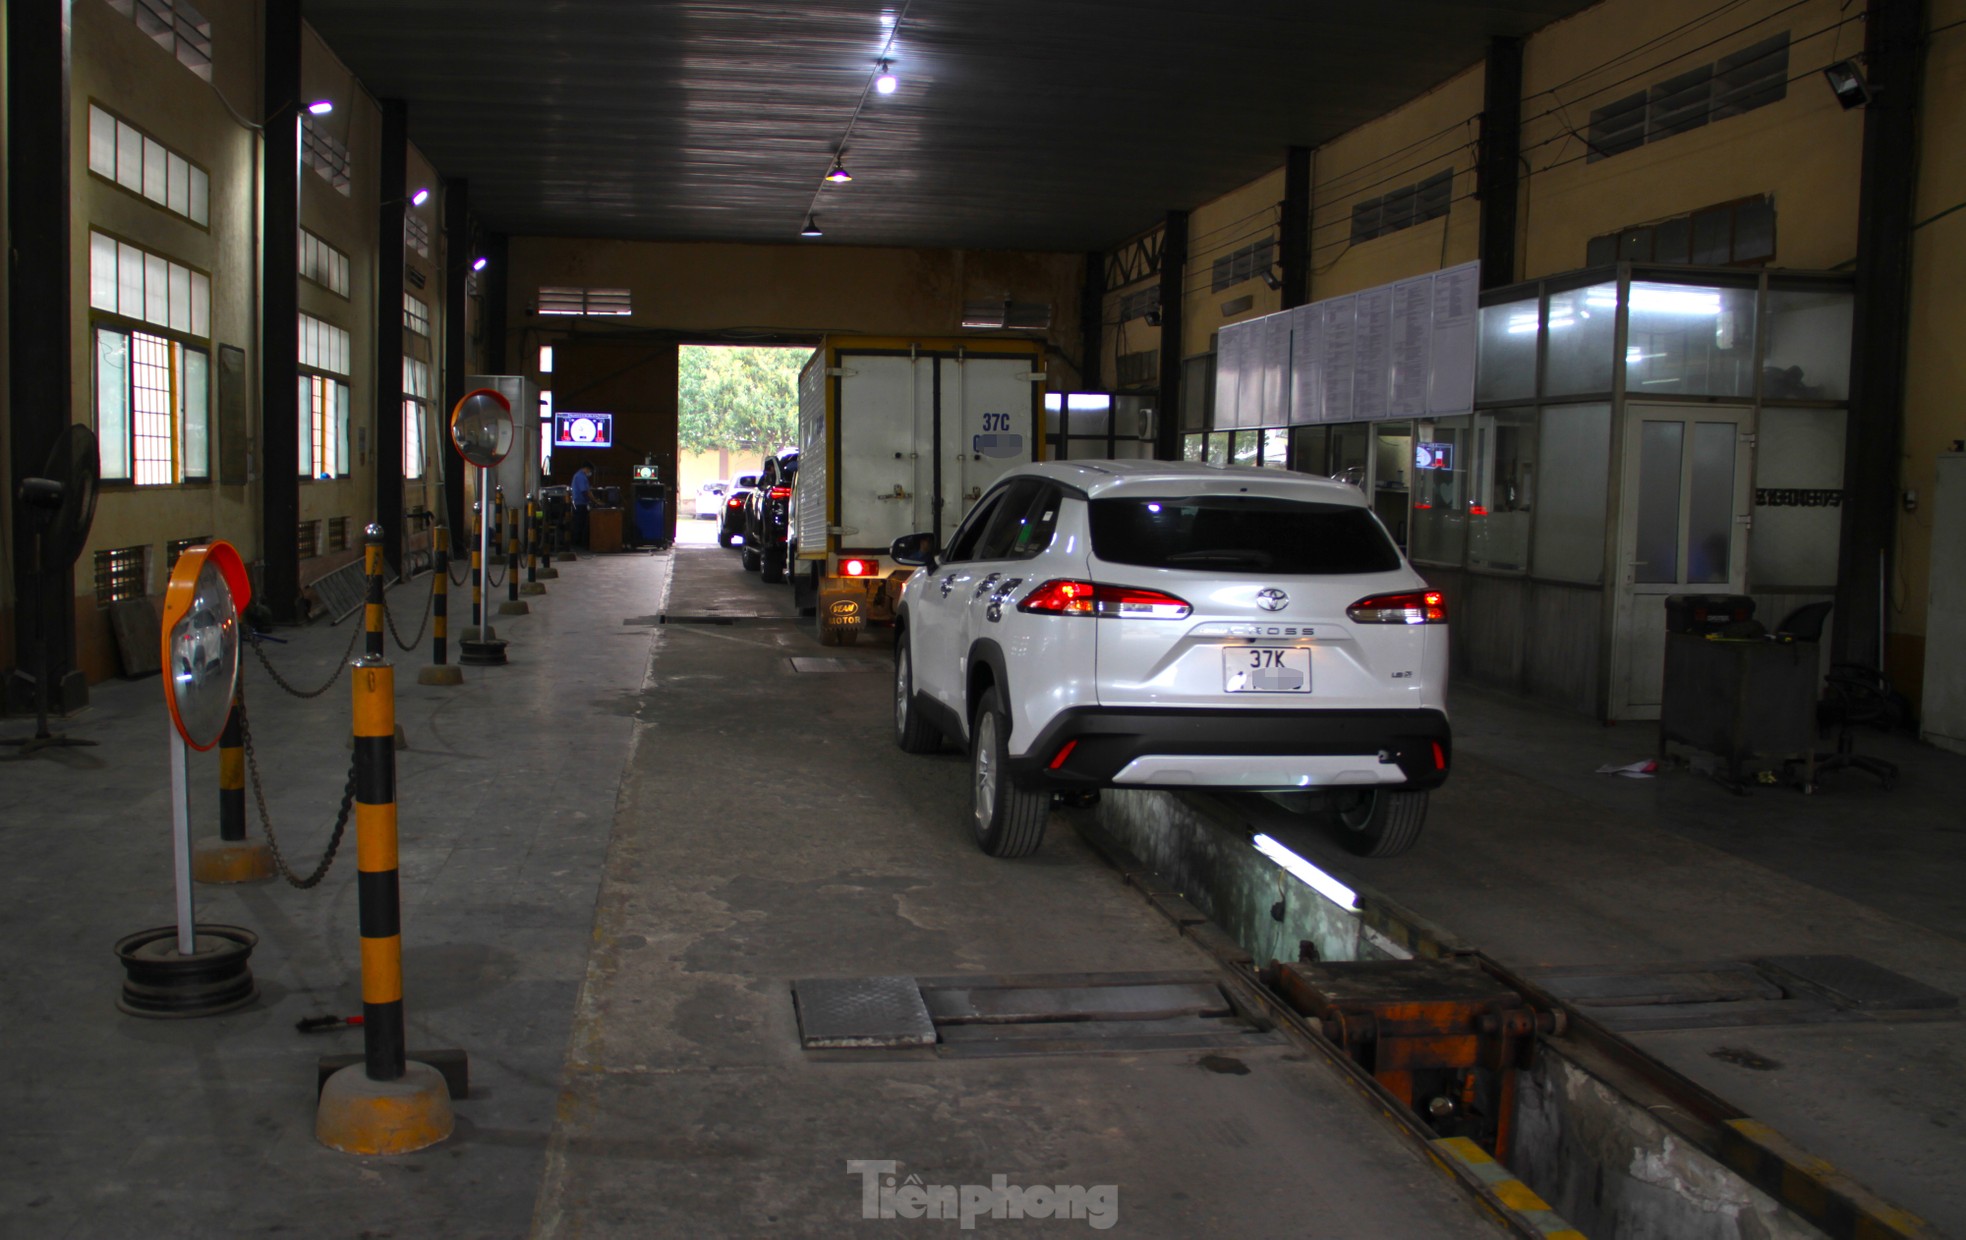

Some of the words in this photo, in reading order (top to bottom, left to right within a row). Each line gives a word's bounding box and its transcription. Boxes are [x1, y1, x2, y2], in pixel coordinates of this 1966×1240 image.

[982, 413, 1010, 431] 37C
[829, 616, 861, 625] MOTOR
[1230, 626, 1315, 636] CROSS
[1250, 650, 1285, 668] 37K
